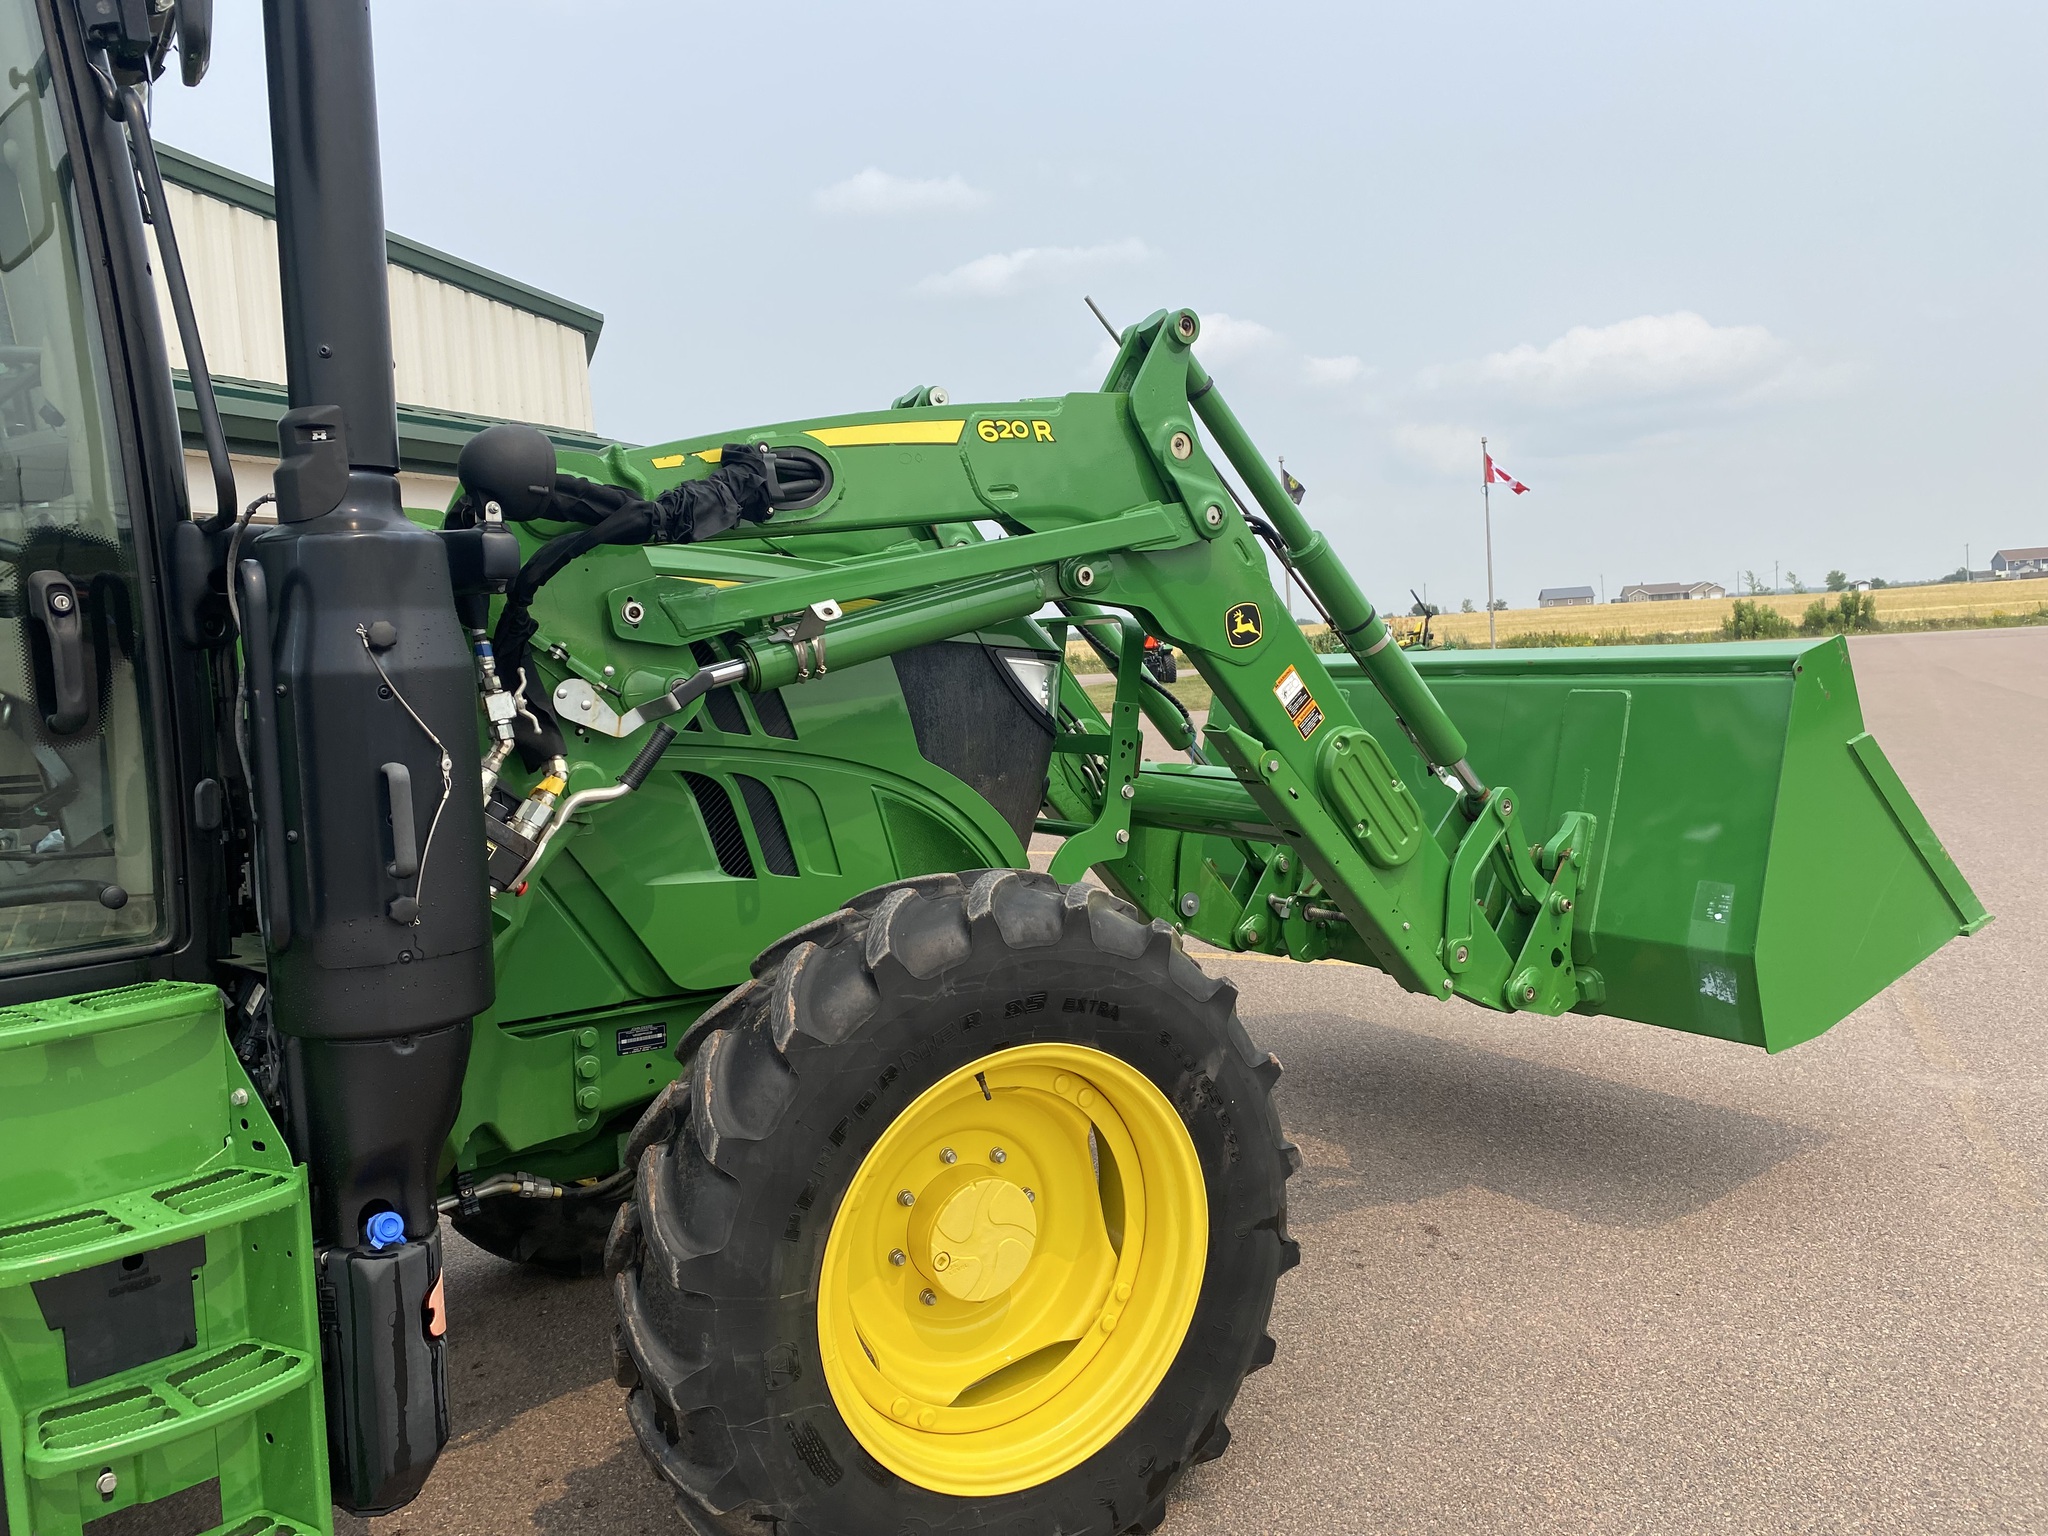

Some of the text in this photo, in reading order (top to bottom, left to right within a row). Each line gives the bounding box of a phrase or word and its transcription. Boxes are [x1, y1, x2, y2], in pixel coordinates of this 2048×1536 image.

[977, 419, 1057, 443] 620 R
[782, 1008, 984, 1243] PERFORMER
[1062, 997, 1120, 1022] EXTRA
